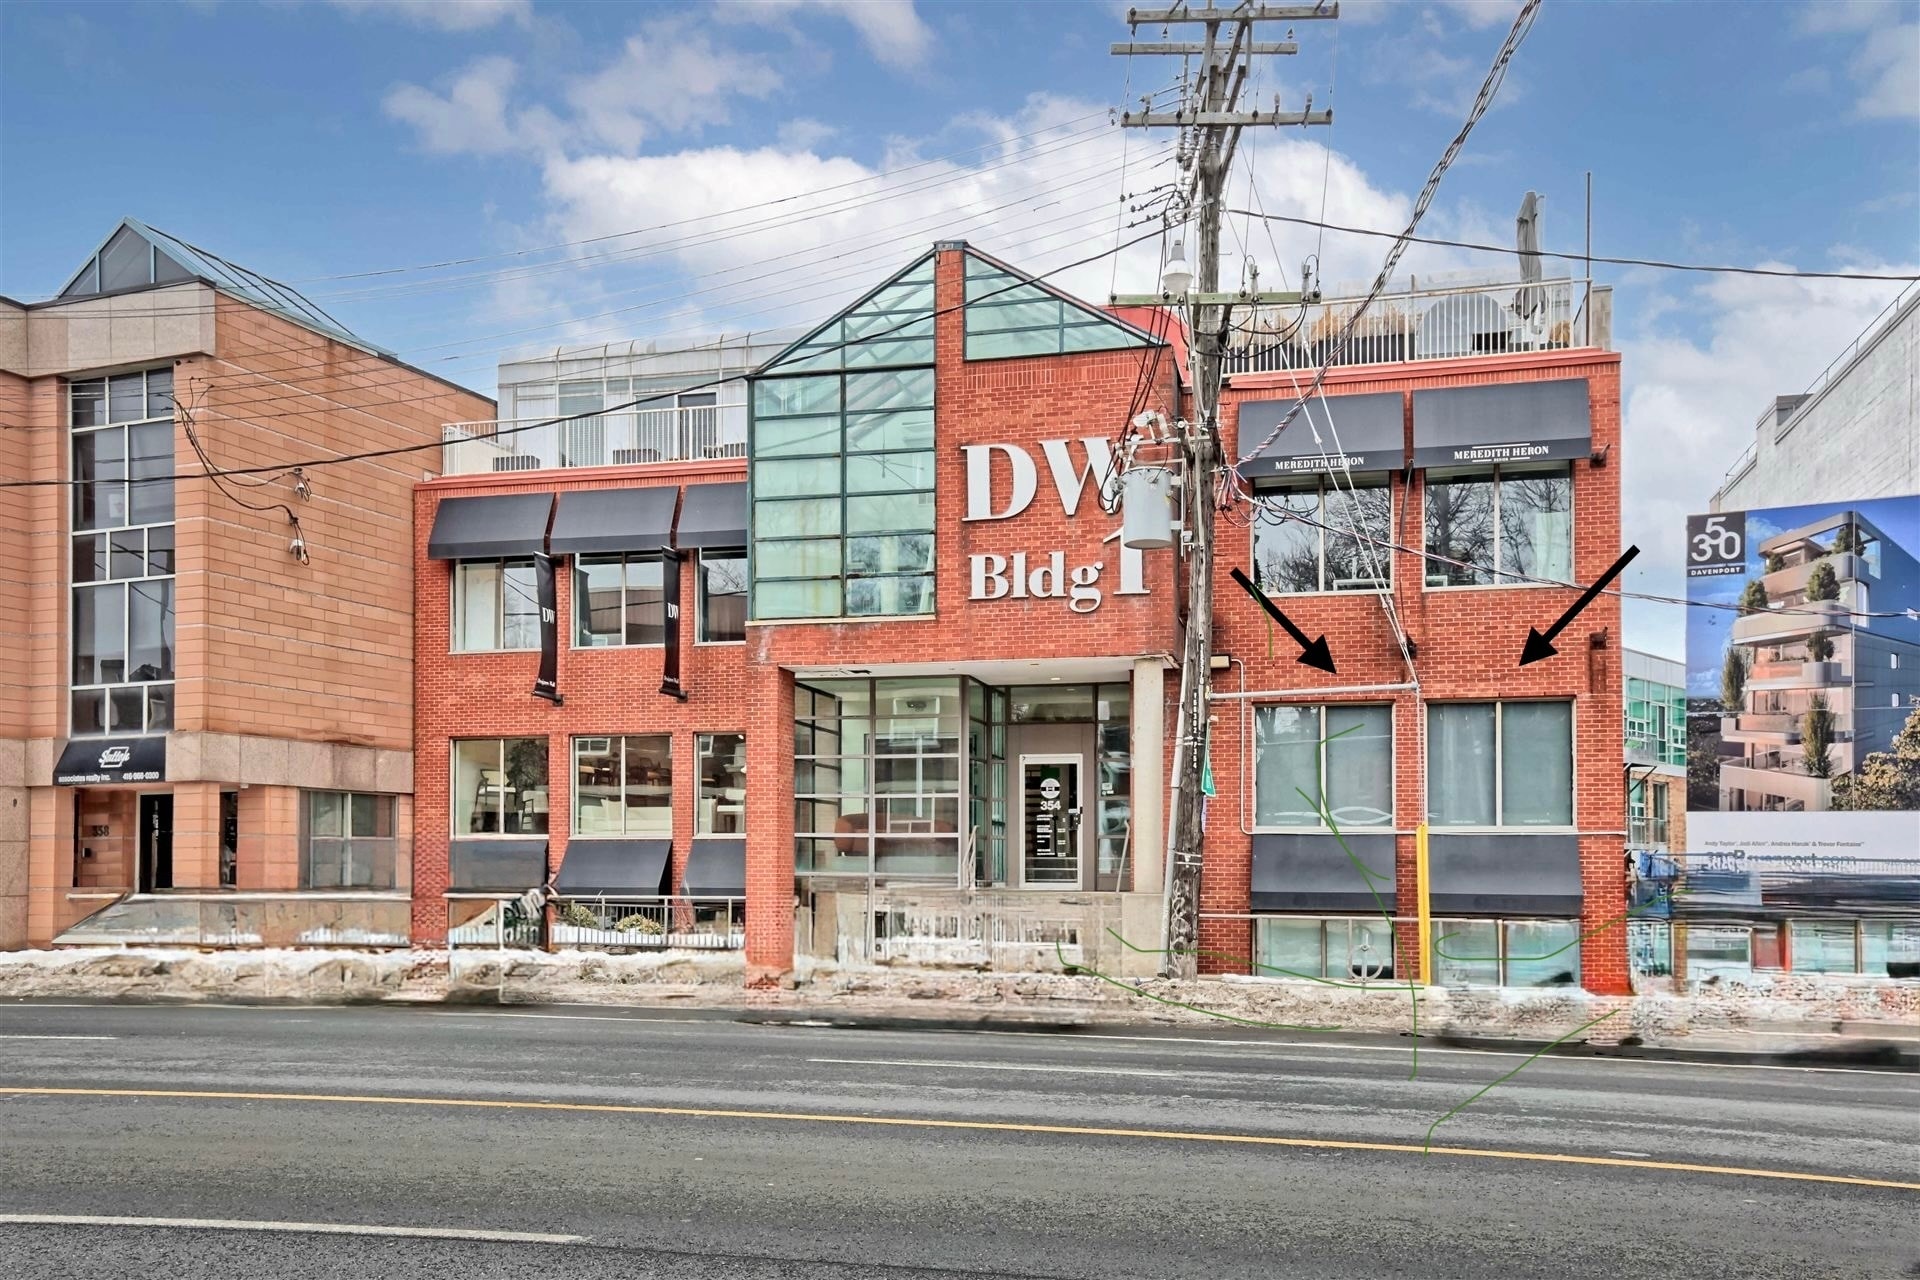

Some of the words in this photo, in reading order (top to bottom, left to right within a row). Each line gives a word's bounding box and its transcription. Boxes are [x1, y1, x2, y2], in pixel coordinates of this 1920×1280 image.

[1454, 448, 1510, 460] MEREDITH
[1512, 445, 1549, 456] HERON
[1275, 459, 1328, 470] MEREDITH
[960, 436, 1144, 522] DW
[1691, 516, 1741, 562] 350
[968, 551, 1104, 613] Bldg
[1103, 526, 1150, 595] 1
[1691, 567, 1741, 576] DAVENPORT
[542, 607, 556, 625] DW
[1040, 800, 1061, 811] 354
